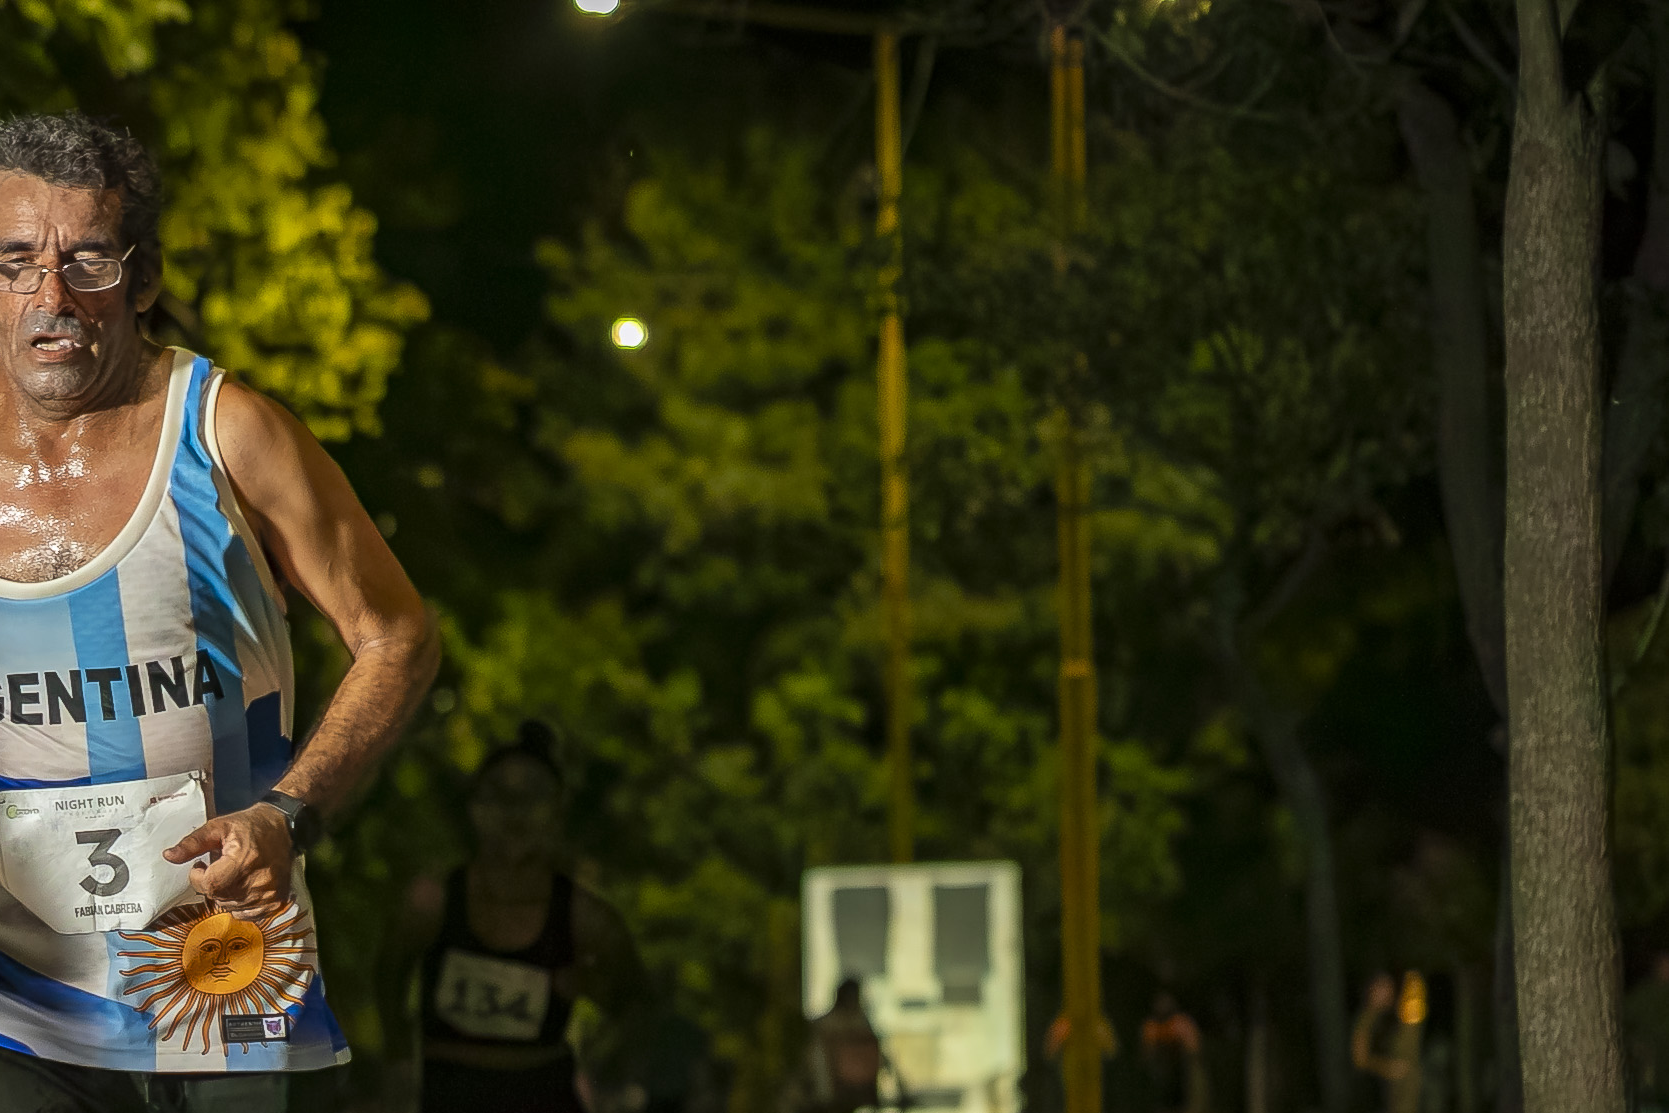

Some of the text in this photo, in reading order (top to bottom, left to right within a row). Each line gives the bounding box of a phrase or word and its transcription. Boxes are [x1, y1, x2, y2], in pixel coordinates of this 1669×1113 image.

[55, 795, 125, 811] NIGHT RUN
[75, 828, 130, 897] 3
